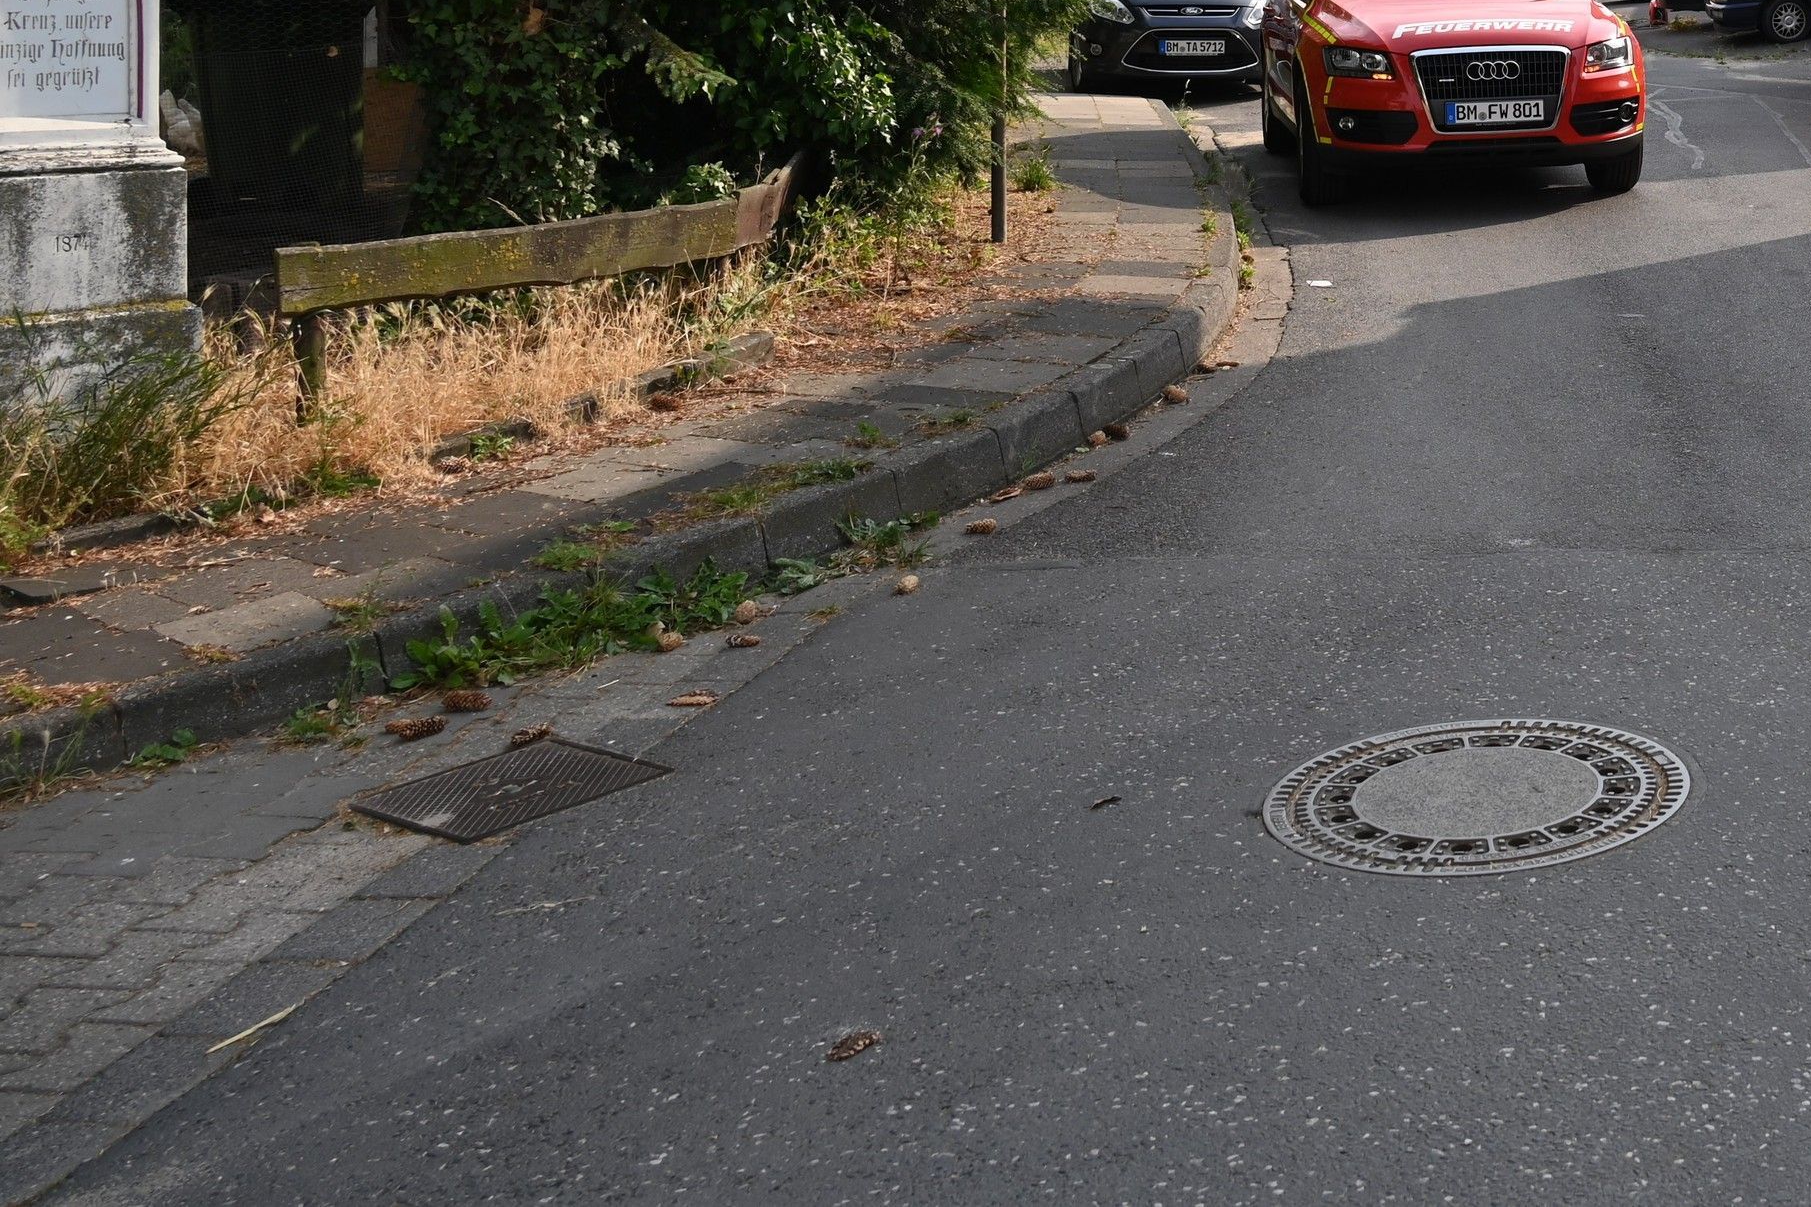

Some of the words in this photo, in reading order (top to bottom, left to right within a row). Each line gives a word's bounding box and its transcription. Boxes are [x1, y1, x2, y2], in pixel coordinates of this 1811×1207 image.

[1391, 18, 1576, 40] FEUERWEHR
[0, 40, 45, 65] inzige
[50, 38, 126, 66] Hoffnung
[1166, 41, 1178, 52] BM
[1186, 41, 1198, 53] TA
[1199, 41, 1224, 53] 5712
[1455, 104, 1478, 122] BM
[1487, 102, 1508, 120] FW
[1512, 101, 1542, 119] 801
